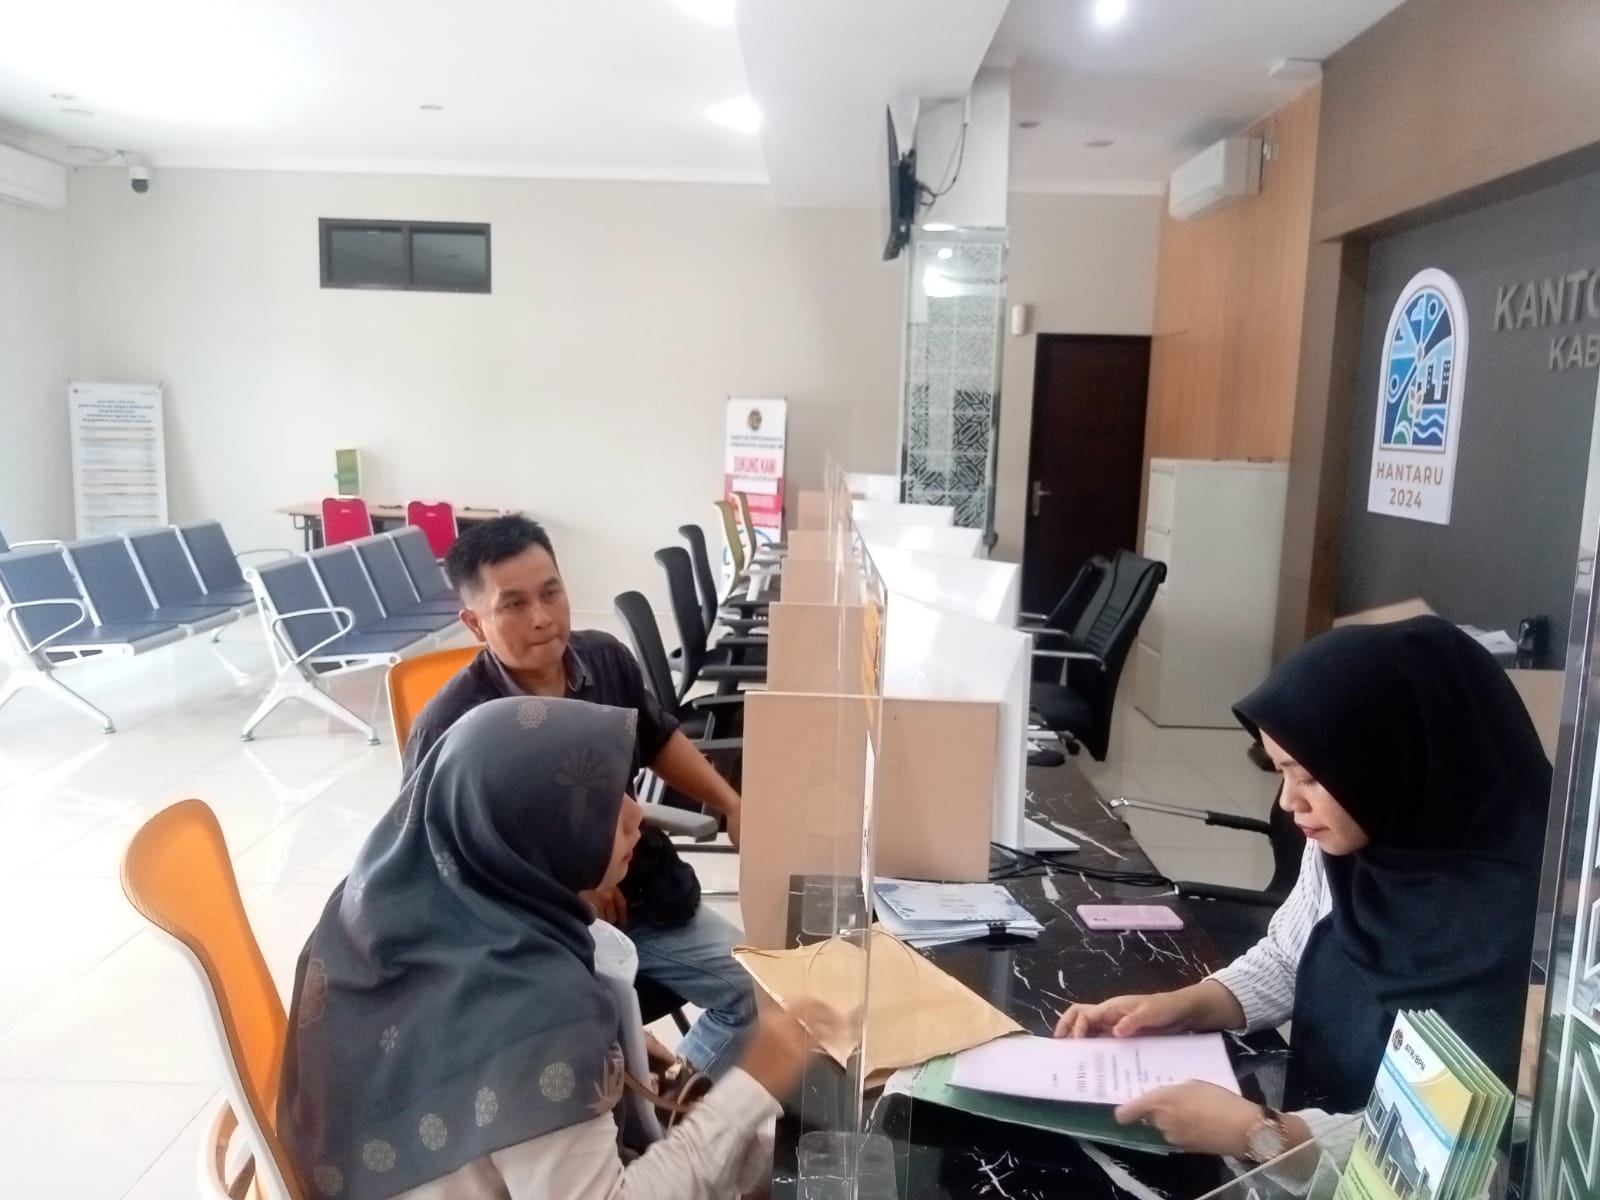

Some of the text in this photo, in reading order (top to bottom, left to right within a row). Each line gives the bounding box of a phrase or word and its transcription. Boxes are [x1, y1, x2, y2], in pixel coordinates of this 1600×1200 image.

[1376, 461, 1444, 486] HANTARU
[1389, 487, 1422, 510] 2024
[1404, 1043, 1426, 1071] ATR/BPN
